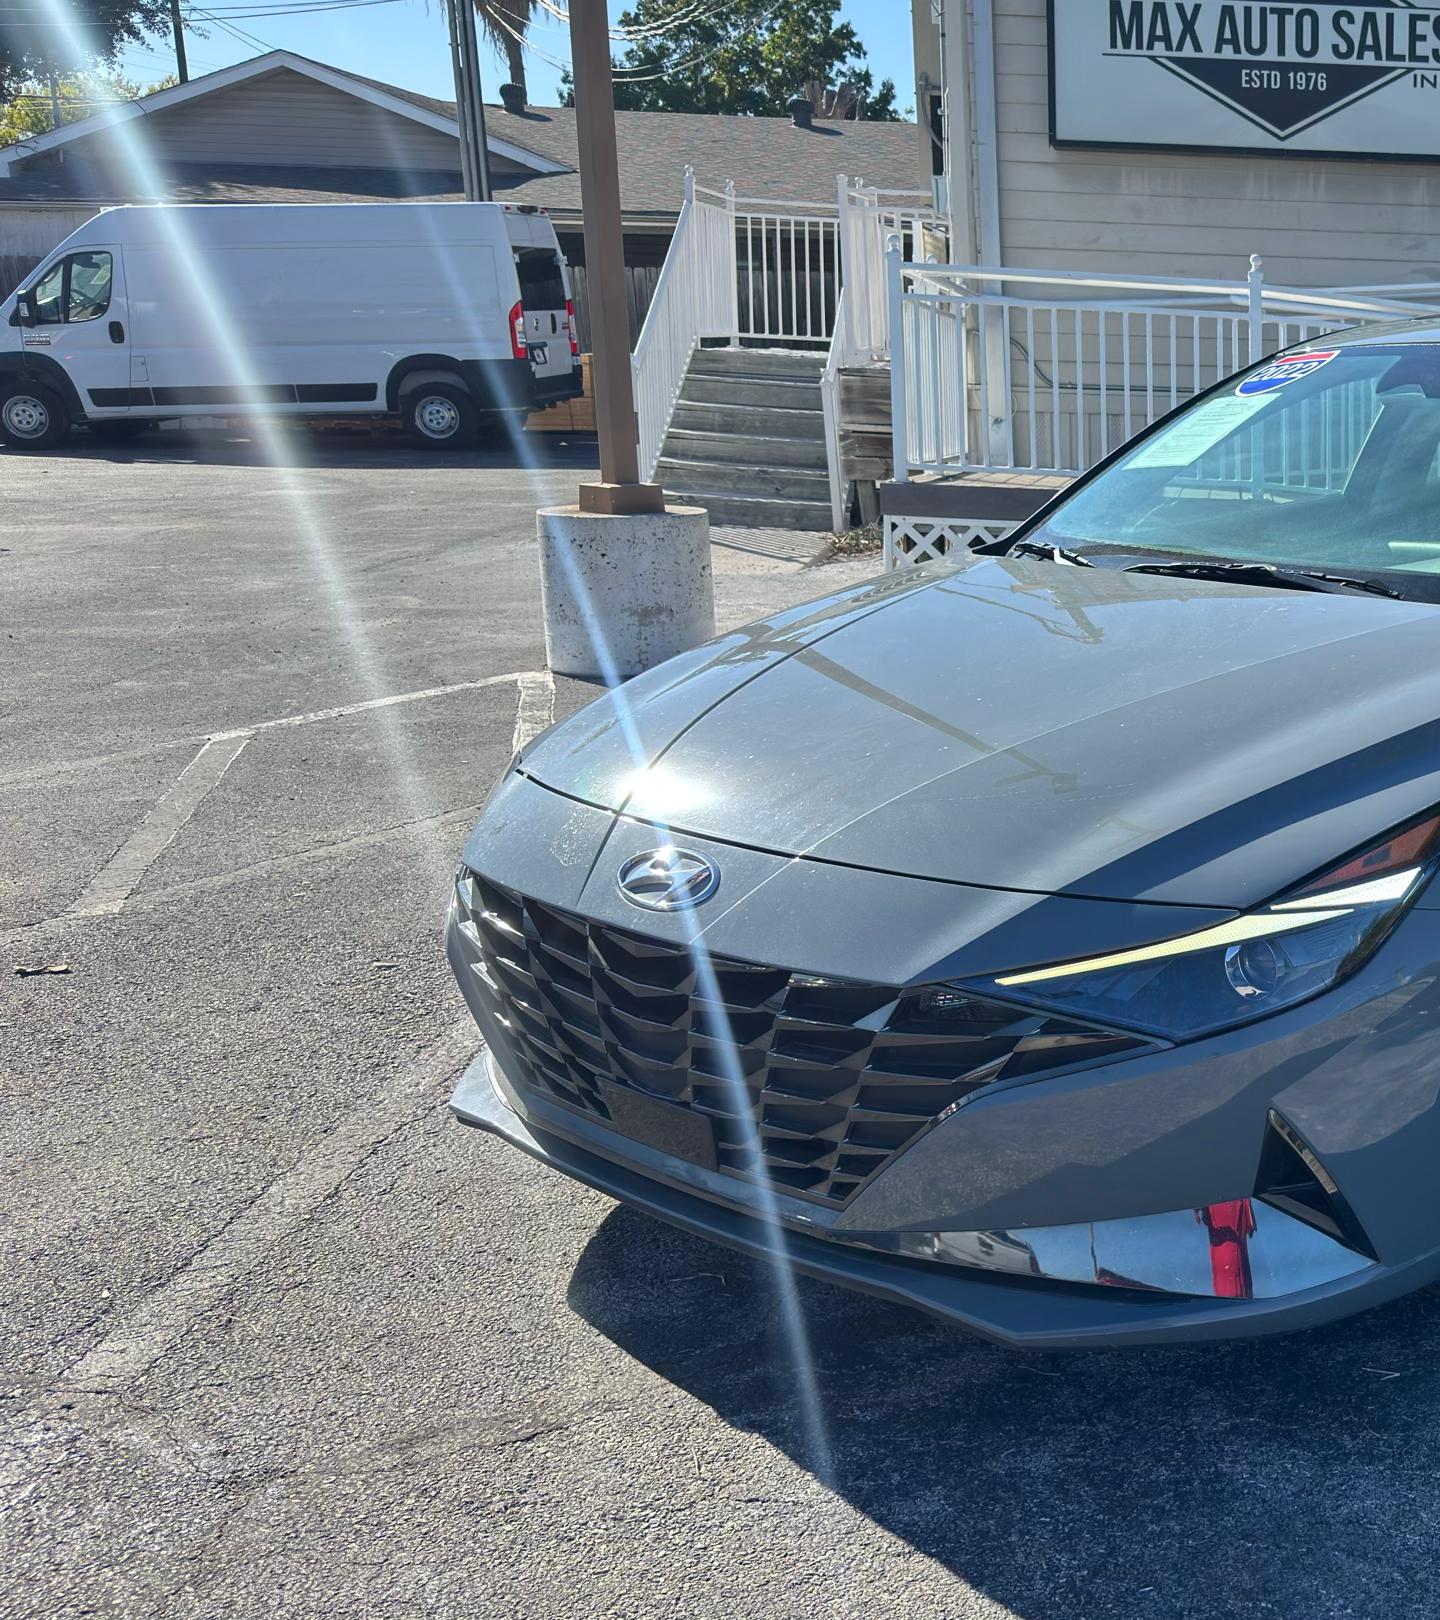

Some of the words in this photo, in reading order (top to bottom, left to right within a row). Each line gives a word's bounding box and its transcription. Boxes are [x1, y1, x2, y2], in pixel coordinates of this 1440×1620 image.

[1109, 0, 1203, 53] MAX
[1214, 5, 1320, 58] AUTO
[1241, 69, 1281, 89] ESTD
[1288, 71, 1327, 92] 1976
[1247, 361, 1320, 382] 2022
